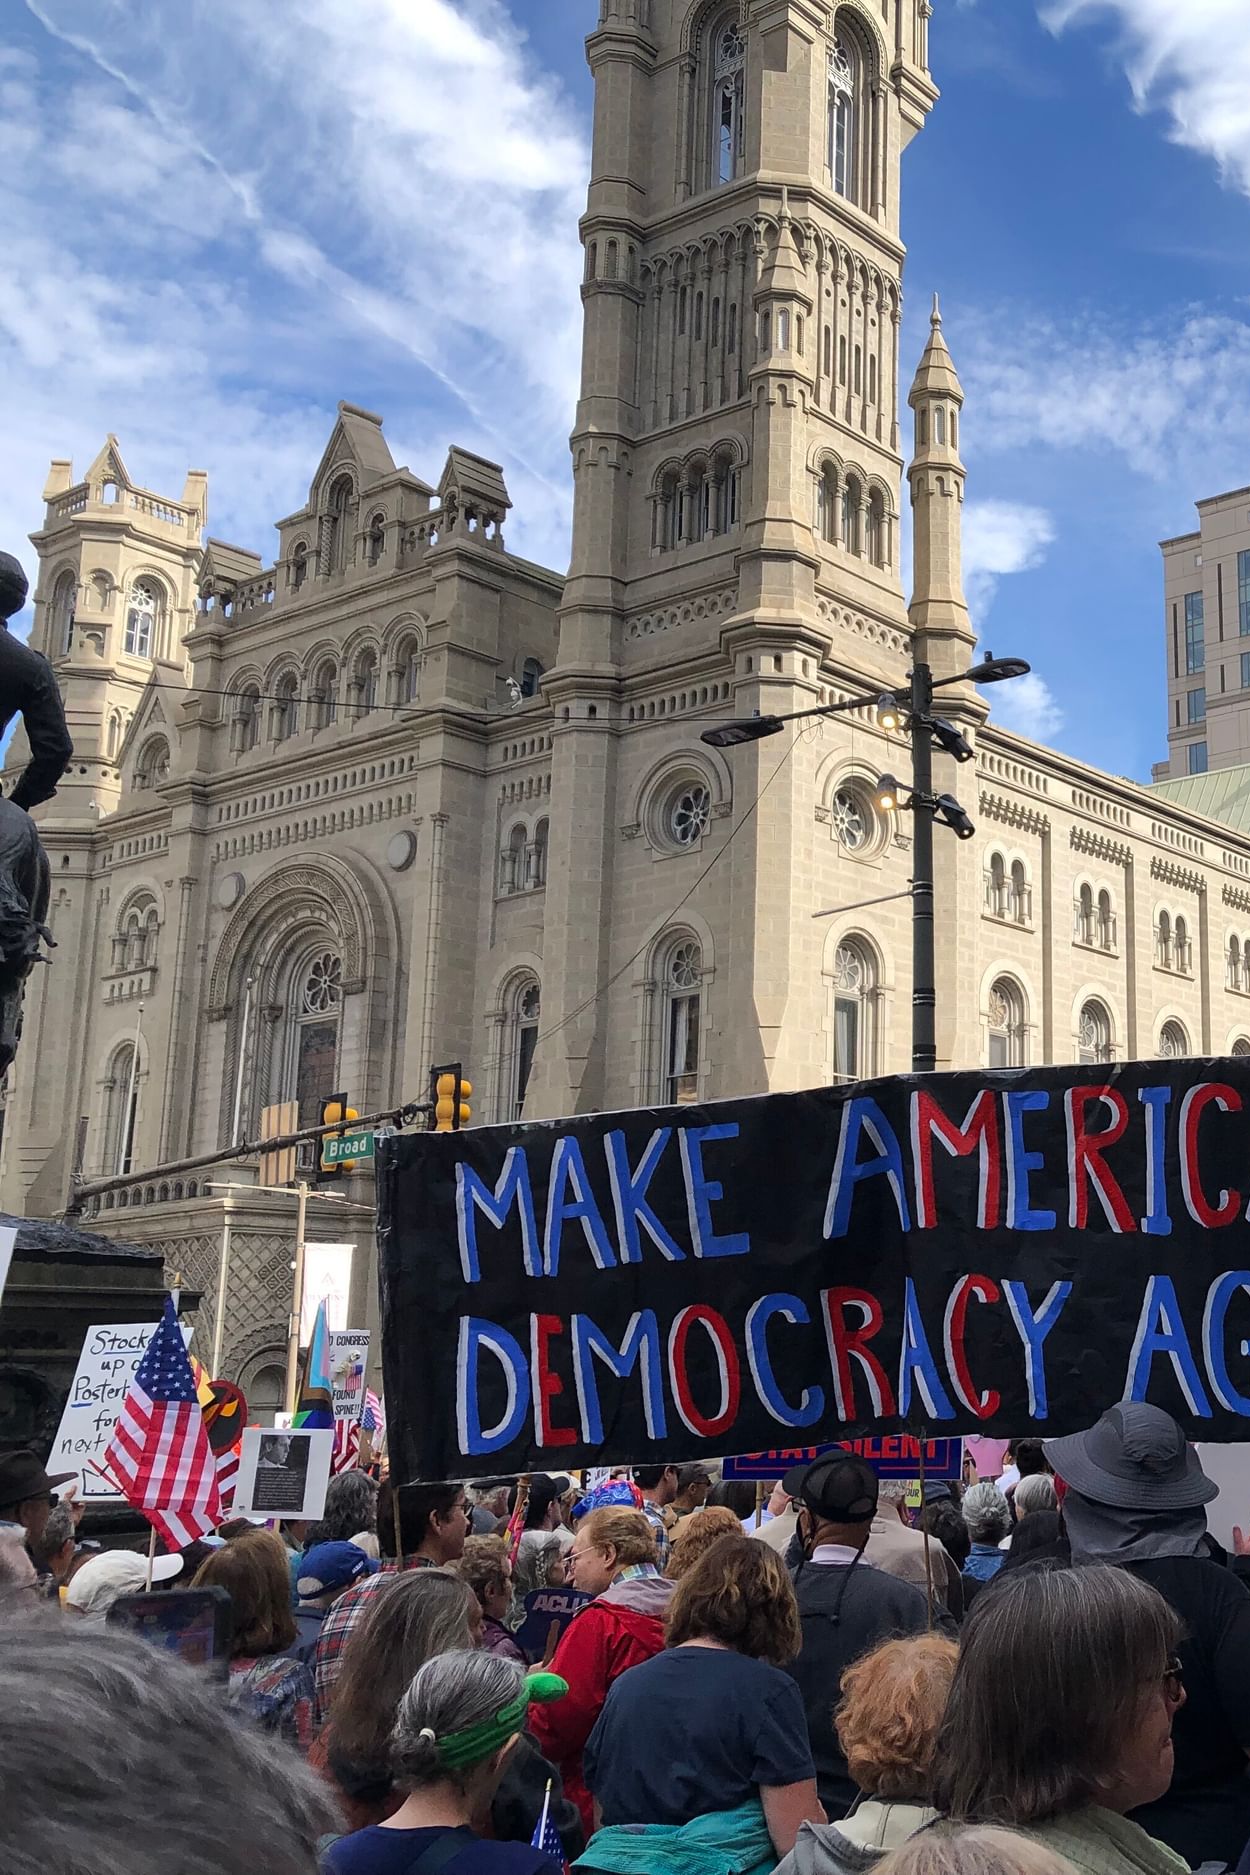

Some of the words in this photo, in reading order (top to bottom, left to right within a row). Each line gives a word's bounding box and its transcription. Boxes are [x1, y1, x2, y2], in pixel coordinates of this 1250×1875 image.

[329, 1136, 367, 1157] Broad
[455, 1122, 750, 1283] MAKE
[91, 1329, 152, 1355] Stock
[336, 1335, 371, 1347] CONGRESS
[100, 1359, 126, 1378] up
[455, 1273, 1073, 1456] DEMOCRACY
[332, 1389, 356, 1400] FOUND
[92, 1409, 118, 1432] for
[61, 1432, 106, 1454] next
[531, 1594, 589, 1614] ACLU
